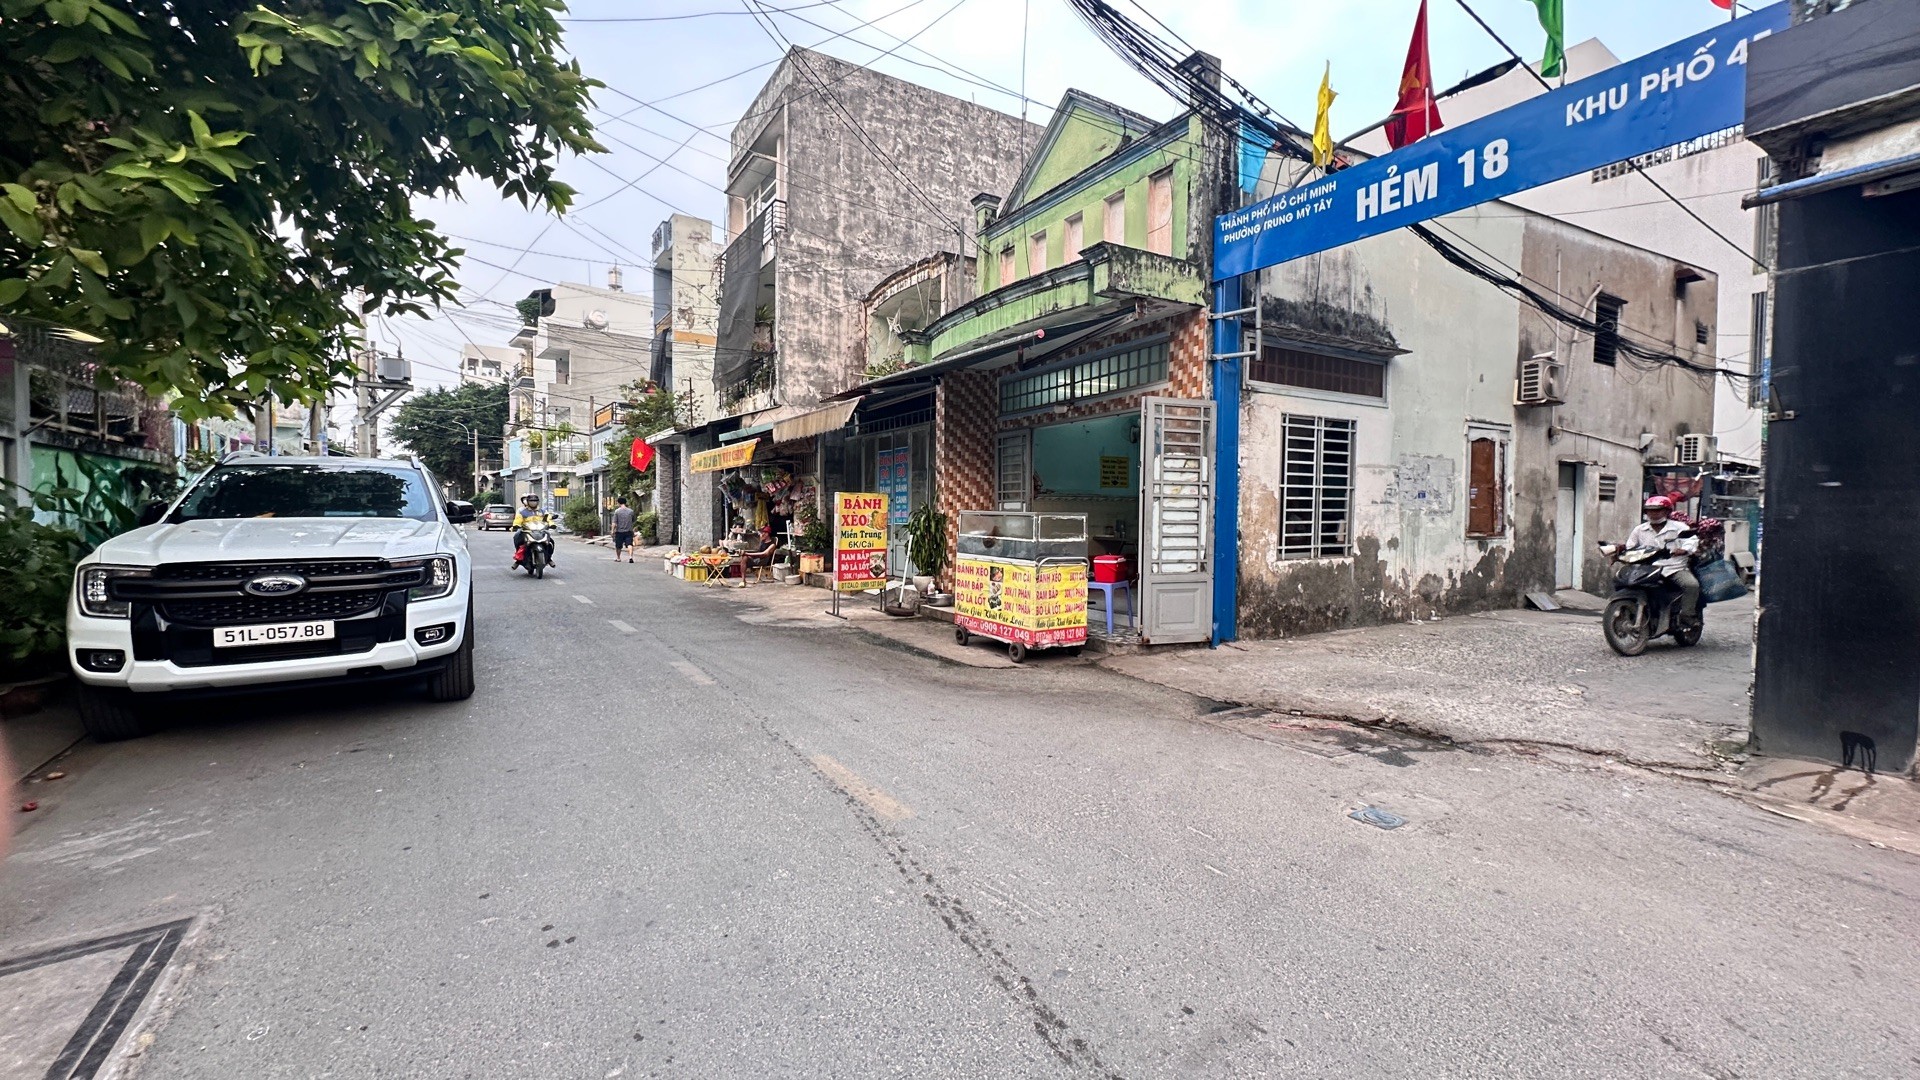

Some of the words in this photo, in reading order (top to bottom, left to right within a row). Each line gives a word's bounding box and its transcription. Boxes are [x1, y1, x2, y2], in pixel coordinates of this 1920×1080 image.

[1566, 83, 1628, 127] KHU
[1639, 38, 1717, 100] PHỐ
[1726, 29, 1772, 66] 4
[1356, 164, 1439, 223] HẺM
[1457, 138, 1509, 188] 18
[1221, 213, 1249, 232] THÀNH
[1251, 201, 1271, 220] PHỐ
[1272, 194, 1287, 213] HỒ
[1289, 188, 1308, 206] CHÍ
[1309, 180, 1337, 199] MINH
[1223, 222, 1261, 244] PHƯỜNG
[1263, 212, 1294, 231] TRUNG
[1296, 203, 1311, 220] MỸ
[1313, 198, 1333, 214] TÂY
[844, 496, 882, 510] BÁNH
[842, 511, 867, 526] XÈO
[860, 530, 882, 539] Trung
[848, 540, 874, 548] 6K/Cái
[957, 563, 974, 575] BÁNH
[976, 565, 989, 577] XÈO
[1052, 570, 1062, 582] XÈO
[260, 581, 289, 592] Ford
[957, 579, 970, 590] RAM
[957, 591, 965, 601] BÒ
[966, 592, 973, 604] LÁ
[224, 624, 325, 643] 51L-057.88
[980, 620, 998, 632] 0909
[1000, 625, 1013, 637] 127
[1015, 629, 1030, 641] 049
[1066, 628, 1075, 639] 127
